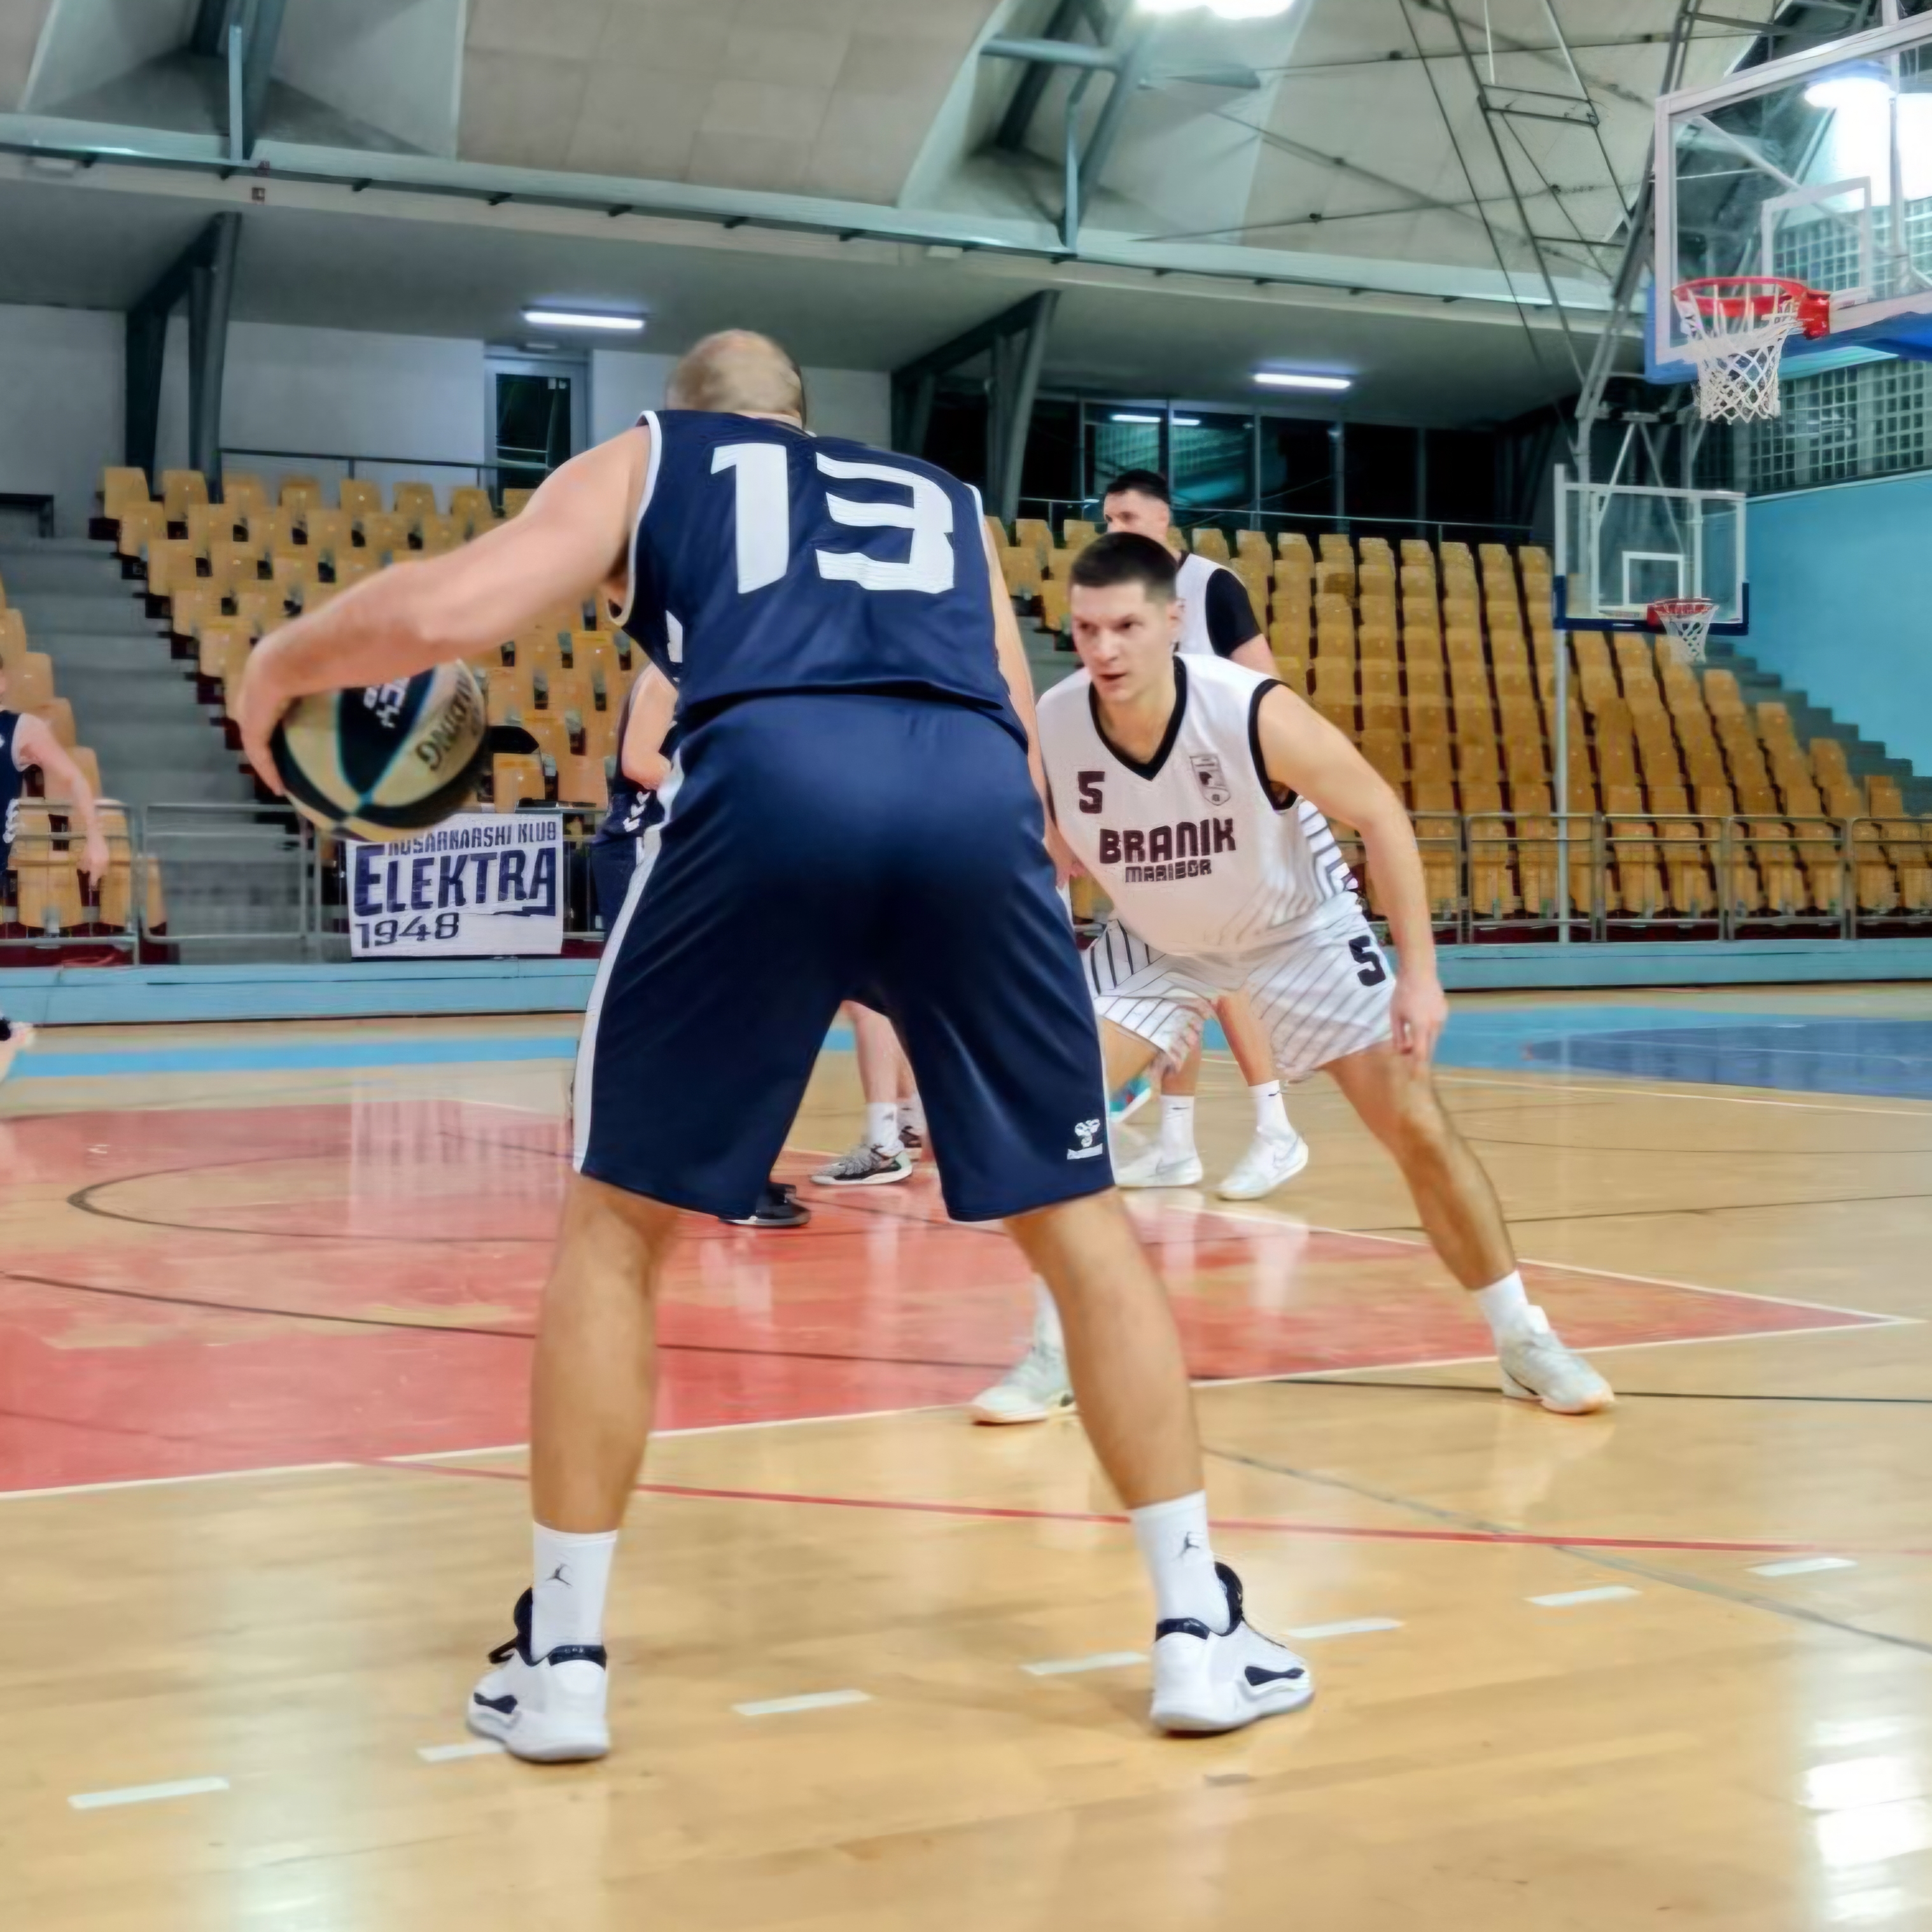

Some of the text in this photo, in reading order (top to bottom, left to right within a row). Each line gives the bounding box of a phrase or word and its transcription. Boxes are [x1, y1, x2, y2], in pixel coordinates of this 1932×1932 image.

[710, 442, 954, 594] 13
[1077, 771, 1105, 814] 5
[518, 822, 556, 843] KLUB
[1099, 818, 1236, 864] BRANIK
[354, 844, 556, 917] ELEKTRA
[1125, 859, 1212, 883] MARIBOR
[355, 913, 459, 948] 1948
[1348, 935, 1386, 986] 5
